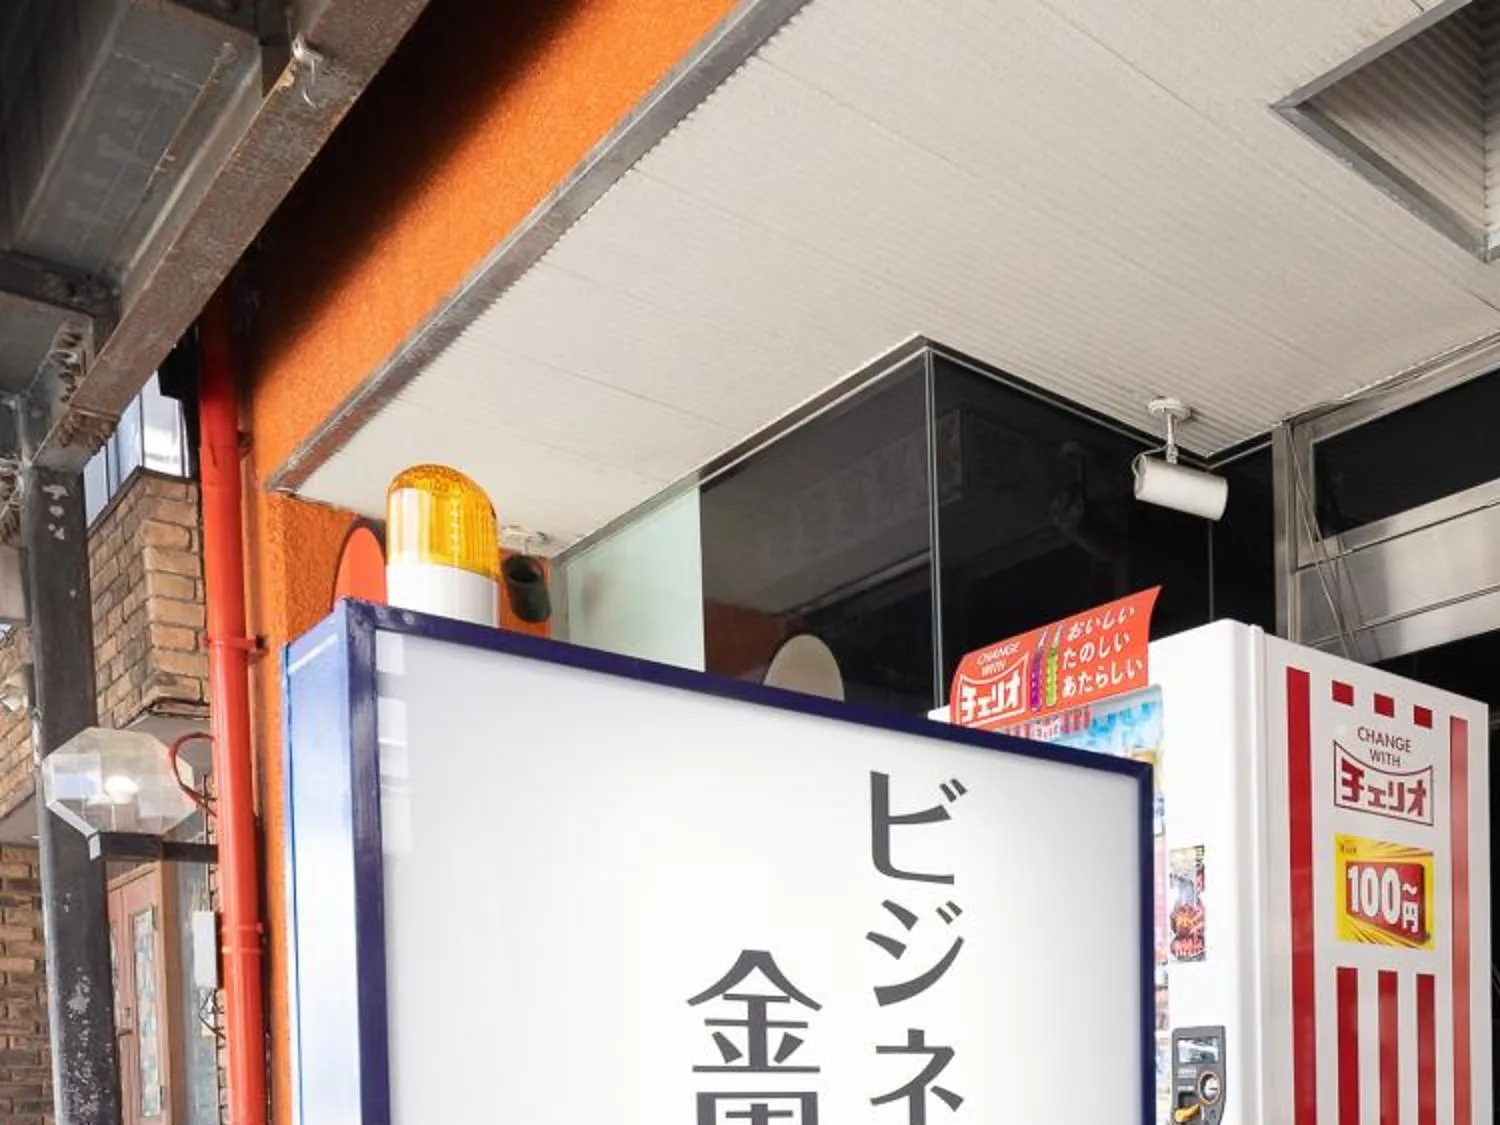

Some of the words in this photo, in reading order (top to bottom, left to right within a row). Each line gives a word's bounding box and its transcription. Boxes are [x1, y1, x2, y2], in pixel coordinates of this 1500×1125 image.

[1068, 607, 1134, 642] おいしい
[1063, 632, 1130, 669] たのしい
[960, 669, 1021, 723] チェリオ
[1062, 658, 1144, 698] あたらしい
[1357, 726, 1412, 753] CHANGE
[1369, 748, 1401, 767] WITH
[1341, 757, 1427, 817] チェリオ
